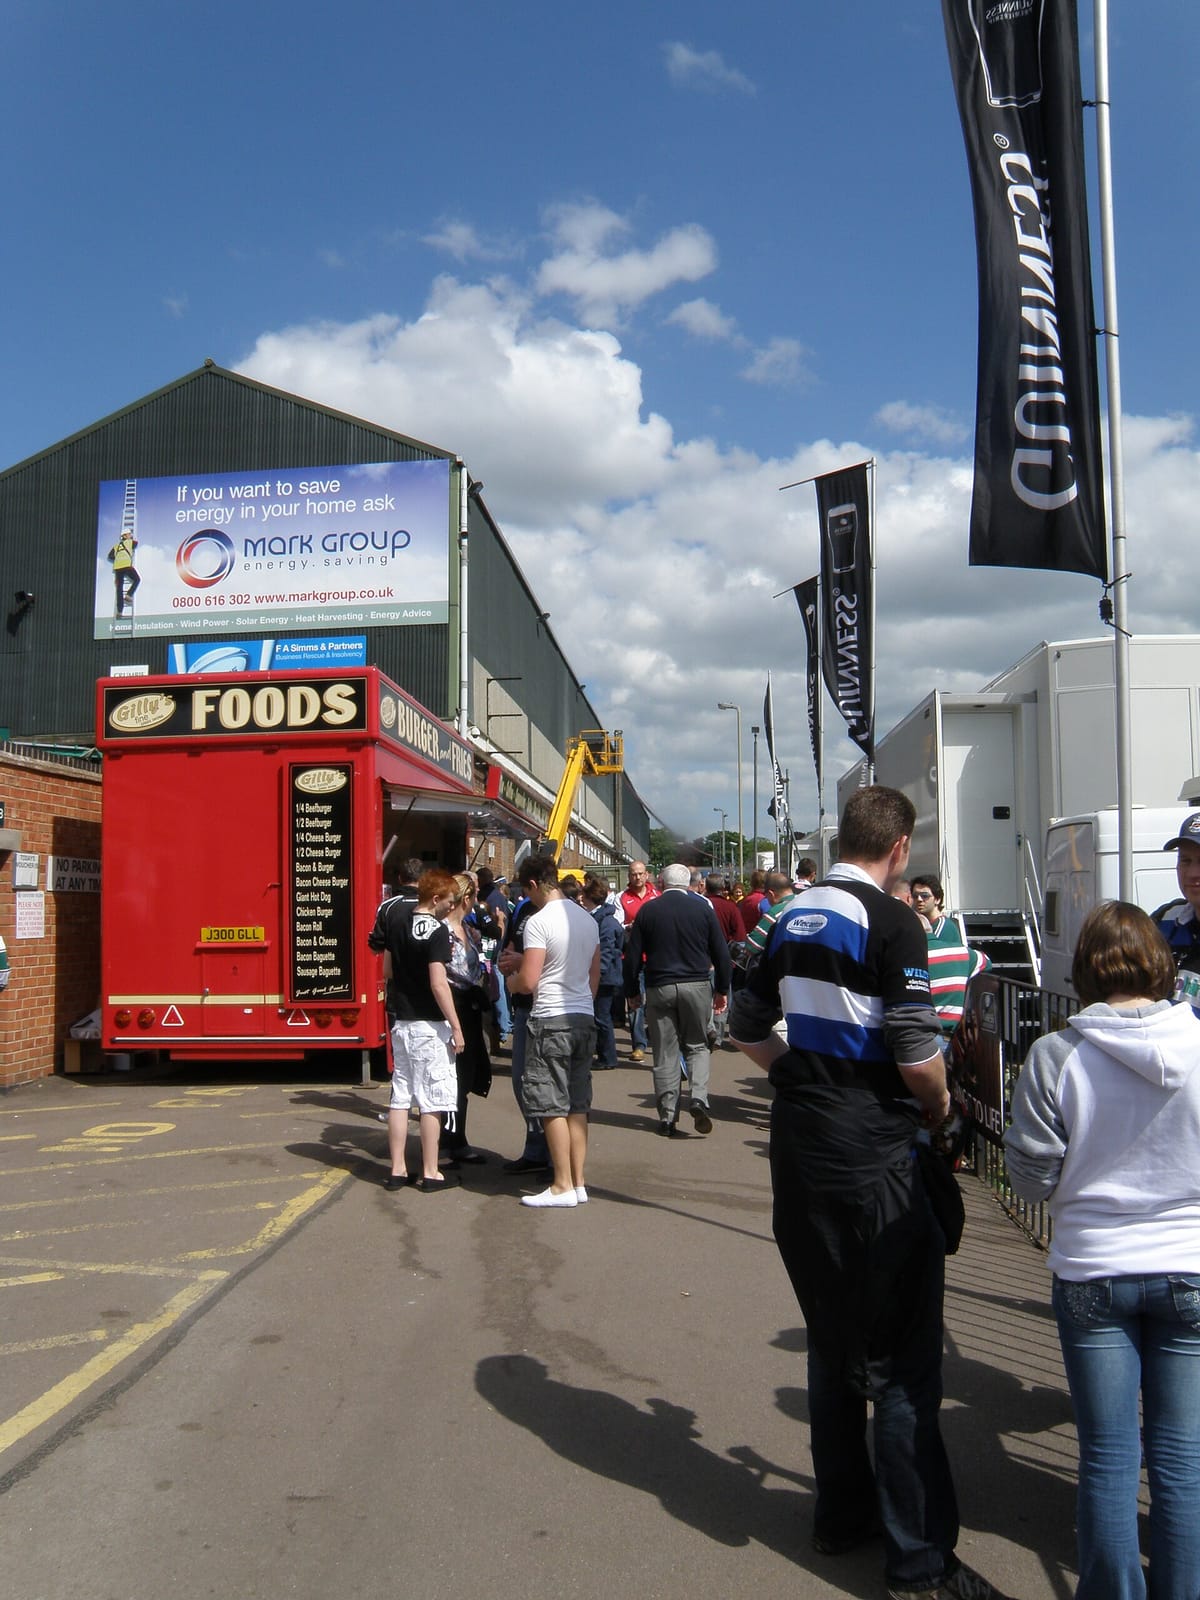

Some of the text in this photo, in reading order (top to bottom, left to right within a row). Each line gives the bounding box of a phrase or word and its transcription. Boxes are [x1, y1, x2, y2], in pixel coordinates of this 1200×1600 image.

[177, 479, 341, 506] If you want to save
[175, 493, 395, 524] energy in your home ask
[324, 554, 388, 566] saving
[172, 587, 394, 608] 0800 616 302 www.markgroup.co.uk
[134, 621, 174, 631] Insulation
[180, 619, 201, 628] Wind
[203, 618, 229, 627] Power
[236, 616, 257, 625] Solar
[259, 614, 289, 626] Energy
[295, 614, 316, 623] Heat
[318, 612, 363, 623] Harvesting
[370, 611, 400, 621] Energy
[402, 609, 432, 618] Advice
[283, 644, 290, 652] A
[290, 643, 319, 652] Simms
[320, 643, 326, 651] &
[328, 642, 363, 651] Partners
[116, 693, 173, 722] Gilly's
[192, 684, 357, 730] FOODS
[398, 700, 472, 782] BURGER and FRIES
[301, 769, 345, 785] Gilly's
[296, 803, 304, 813] 1/4
[296, 817, 304, 828] 1/2
[296, 832, 341, 844] 1/4 Cheese Burger
[296, 847, 341, 859] 1/2 Cheese Burger
[56, 858, 70, 872] NO
[296, 862, 334, 874] Bacon & Burger
[55, 876, 66, 890] AT
[68, 877, 86, 890] ANY
[296, 877, 349, 888] Bacon Cheese Burger
[296, 891, 331, 903] Giant Hot Dog
[296, 906, 334, 918] Chicken Burger
[296, 921, 322, 932] Bacon Roll
[206, 928, 260, 940] J300 GLL
[296, 936, 337, 946] Bacon & Cheese
[296, 951, 312, 961] Bacon
[296, 966, 318, 978] Sausage
[984, 1103, 1001, 1135] LIFE
